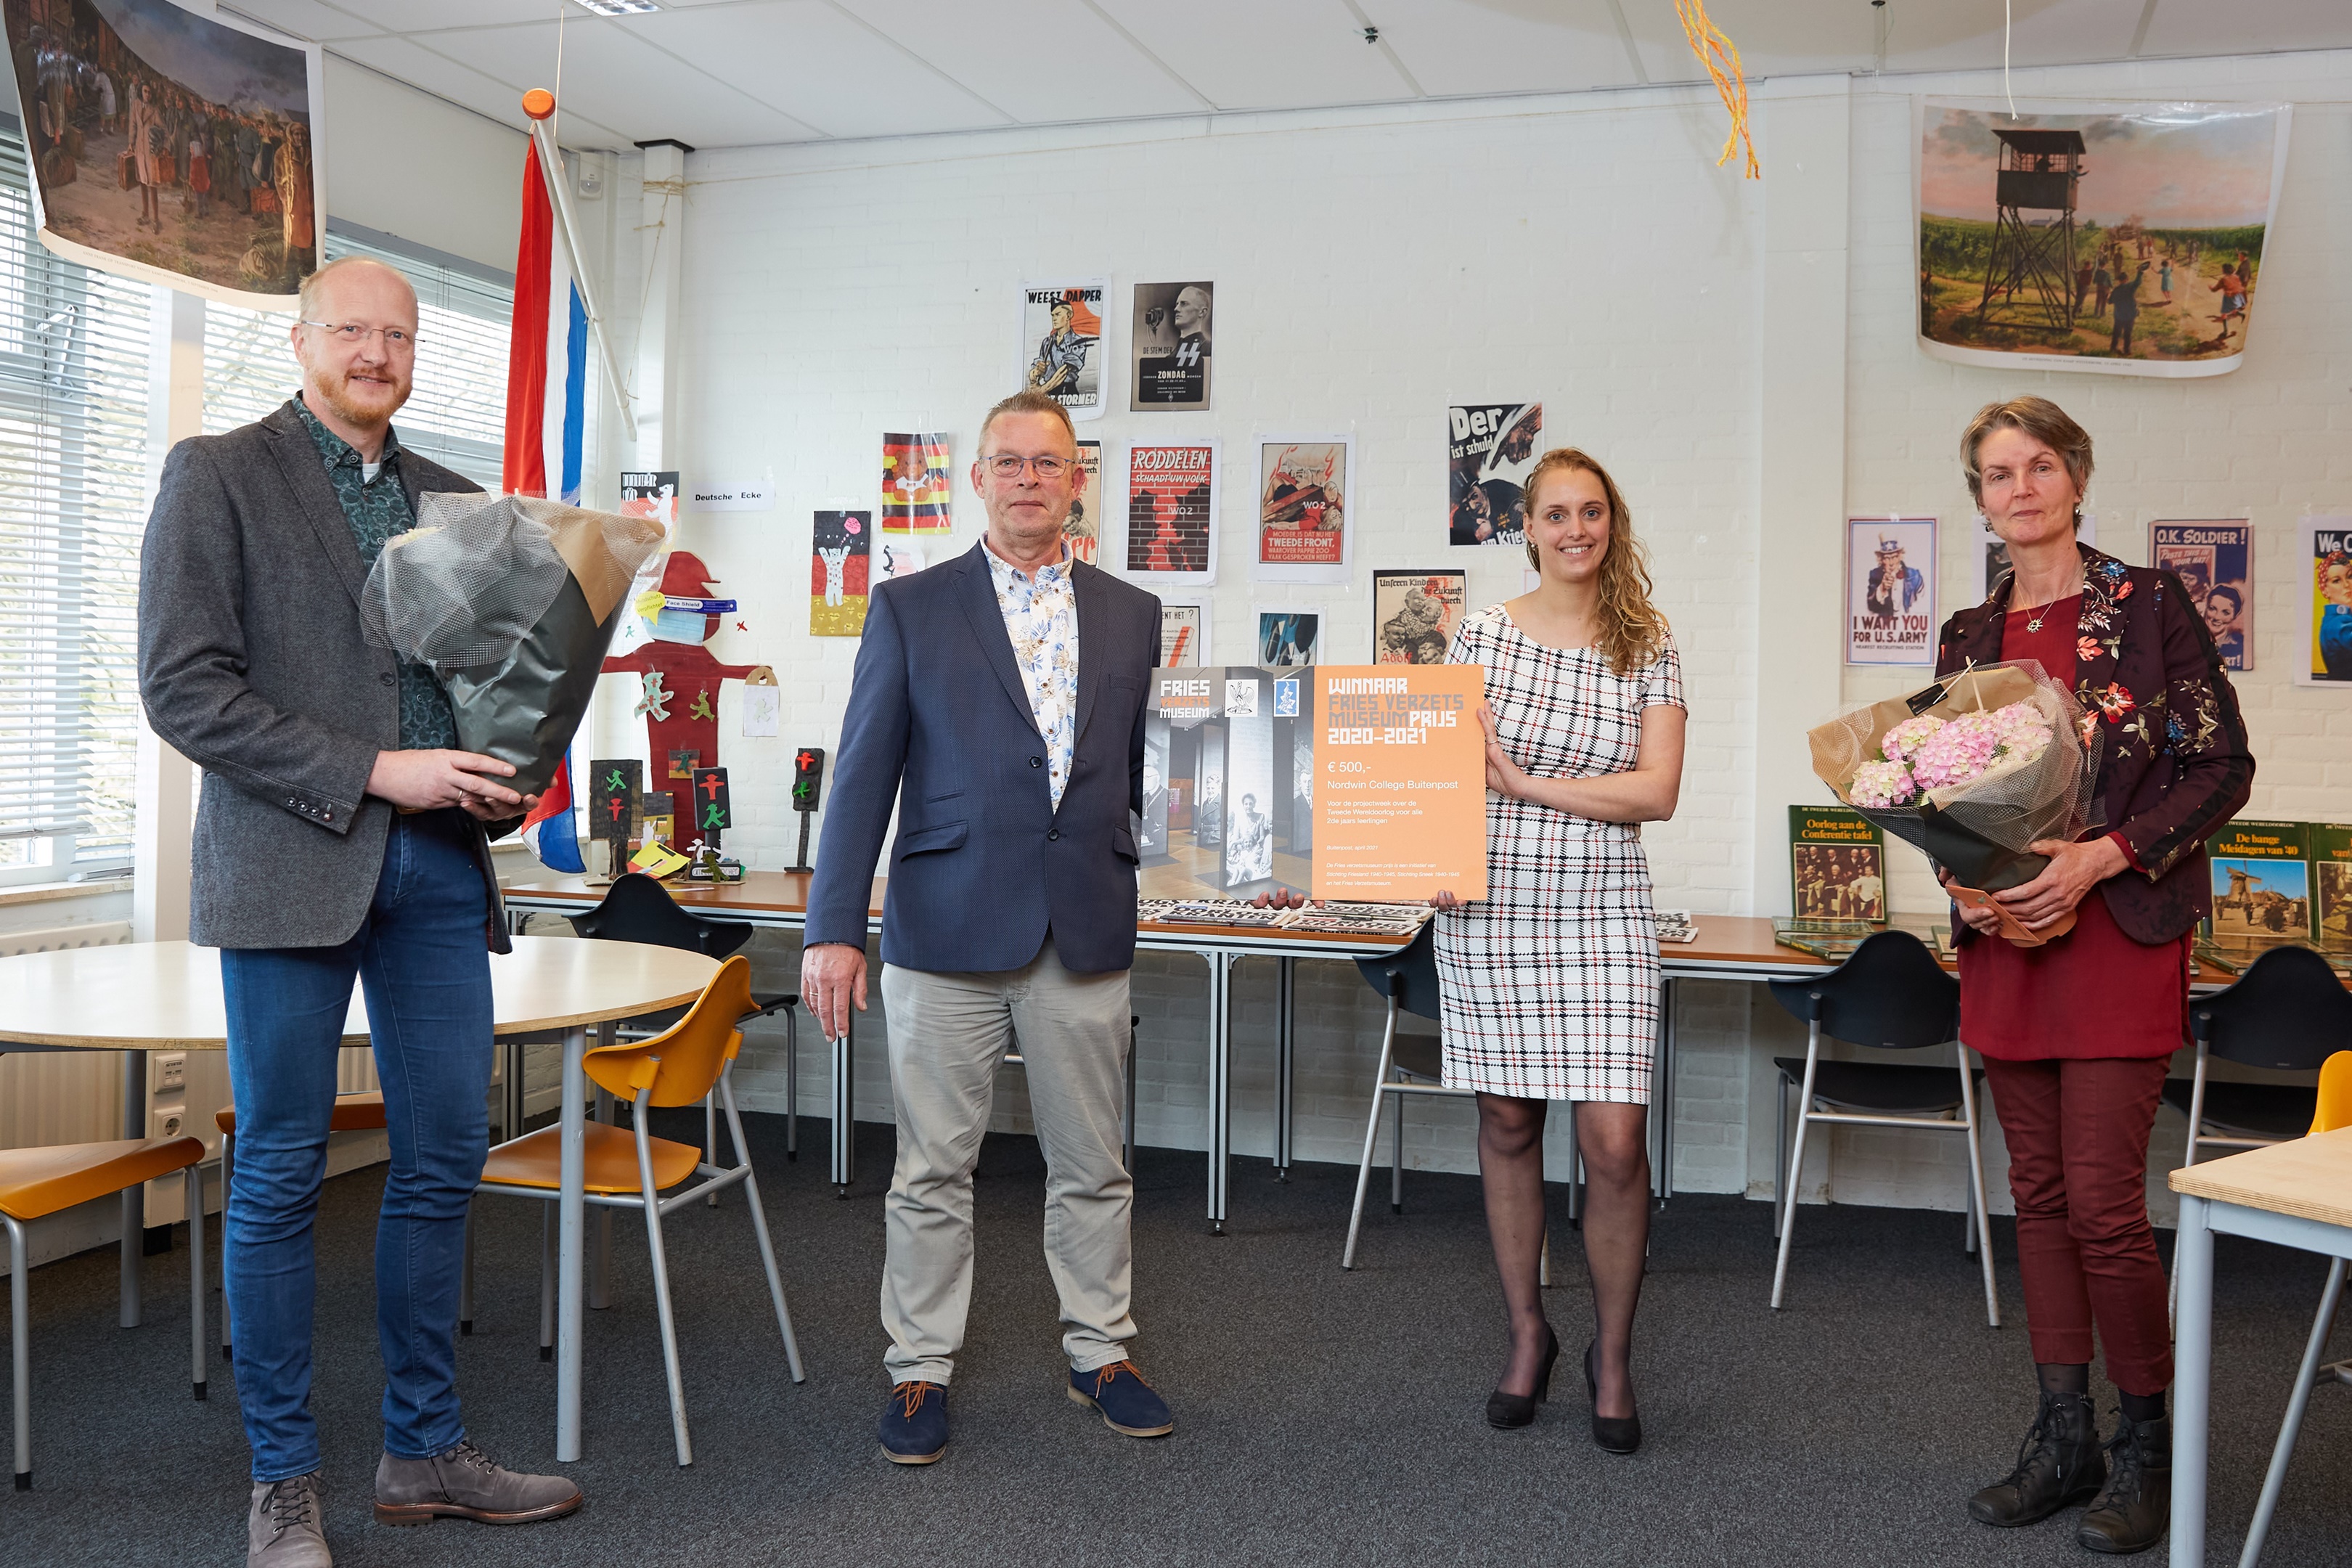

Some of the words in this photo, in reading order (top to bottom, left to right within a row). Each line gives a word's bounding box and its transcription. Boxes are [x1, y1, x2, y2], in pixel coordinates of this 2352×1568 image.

[1066, 290, 1101, 302] DAPPER
[1158, 370, 1185, 379] ZONDAG
[1057, 393, 1096, 406] STORMER
[1450, 407, 1503, 441] Der
[1450, 446, 1463, 459] ist
[1466, 435, 1493, 455] schuld
[1134, 450, 1208, 469] RODDELEN
[1185, 475, 1206, 483] VOLK
[1268, 538, 1302, 547] TWEEDE
[1304, 538, 1334, 547] FRONT,
[2157, 529, 2180, 543] O.K.
[2183, 529, 2237, 544] SOLDIER
[2317, 533, 2341, 552] We
[2160, 550, 2182, 560] PASTE
[1433, 587, 1463, 595] Zukunft
[1189, 610, 1193, 619] ?
[1853, 616, 1857, 629] I
[1862, 616, 1898, 630] WANT
[1902, 616, 1927, 630] YOU
[1853, 632, 1871, 642] FOR
[1381, 652, 1413, 663] Adolf
[1160, 679, 1210, 696] FRIES
[1328, 678, 1408, 694] WINNAAR
[1161, 697, 1209, 707] VERZETS
[1328, 694, 1378, 710] FRIES
[1385, 694, 1463, 710] VERZETS
[1160, 708, 1209, 718] MUSEUM
[1328, 711, 1456, 727] MUSEUMPRIJS
[1328, 727, 1426, 744] 2020-2021
[1328, 761, 1336, 772] €
[1339, 762, 1371, 773] 500,-
[1327, 780, 1366, 789] Nordwin
[1369, 780, 1405, 791] College
[1408, 780, 1458, 790] Buitenpost
[1807, 819, 1837, 830] Oorlog
[1856, 821, 1866, 830] de
[1802, 830, 1851, 839] Conferentie
[1853, 830, 1872, 840] tafel
[2236, 833, 2250, 844] De
[2252, 834, 2279, 846] bange
[2218, 844, 2266, 855] Meidagen
